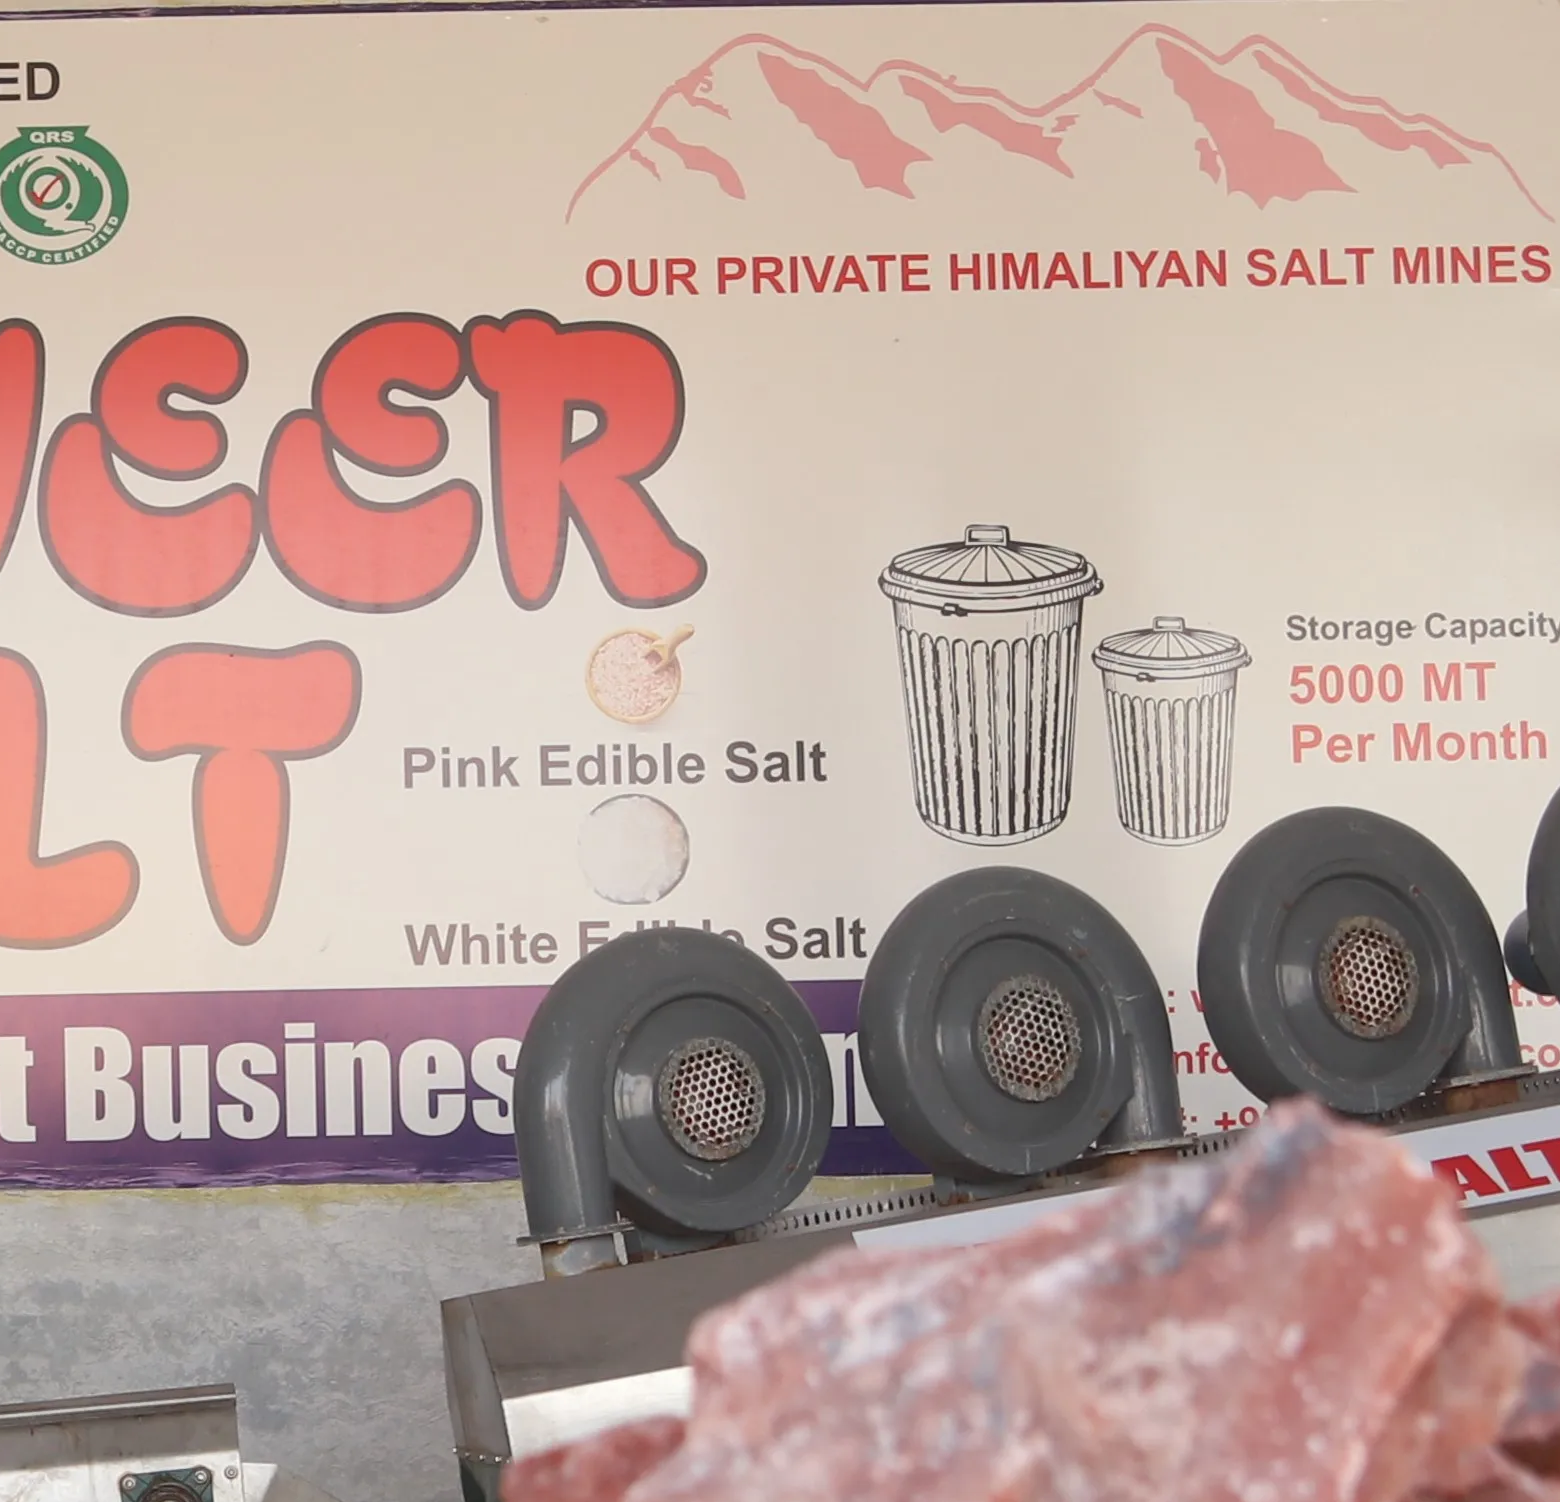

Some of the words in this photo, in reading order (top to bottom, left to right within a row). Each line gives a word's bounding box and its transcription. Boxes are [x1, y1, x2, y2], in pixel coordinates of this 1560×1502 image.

[30, 131, 75, 144] QRS
[42, 215, 119, 263] CERTIFIED
[584, 257, 699, 298] OUR
[716, 253, 930, 295] PRIVATE
[948, 249, 1229, 292] HIMALIYAN
[1246, 246, 1374, 288] SALT
[1391, 244, 1553, 285] MINES
[1286, 614, 1415, 646] Storage
[1289, 664, 1404, 704] 5000
[1423, 662, 1496, 702] MT
[403, 746, 520, 789] Pink
[539, 743, 706, 787] Edible
[725, 740, 827, 784] Salt
[1292, 724, 1375, 763] Per
[1392, 721, 1547, 762] Month
[404, 922, 558, 967] White
[764, 917, 867, 960] Salt
[64, 1022, 523, 1141] Busines
